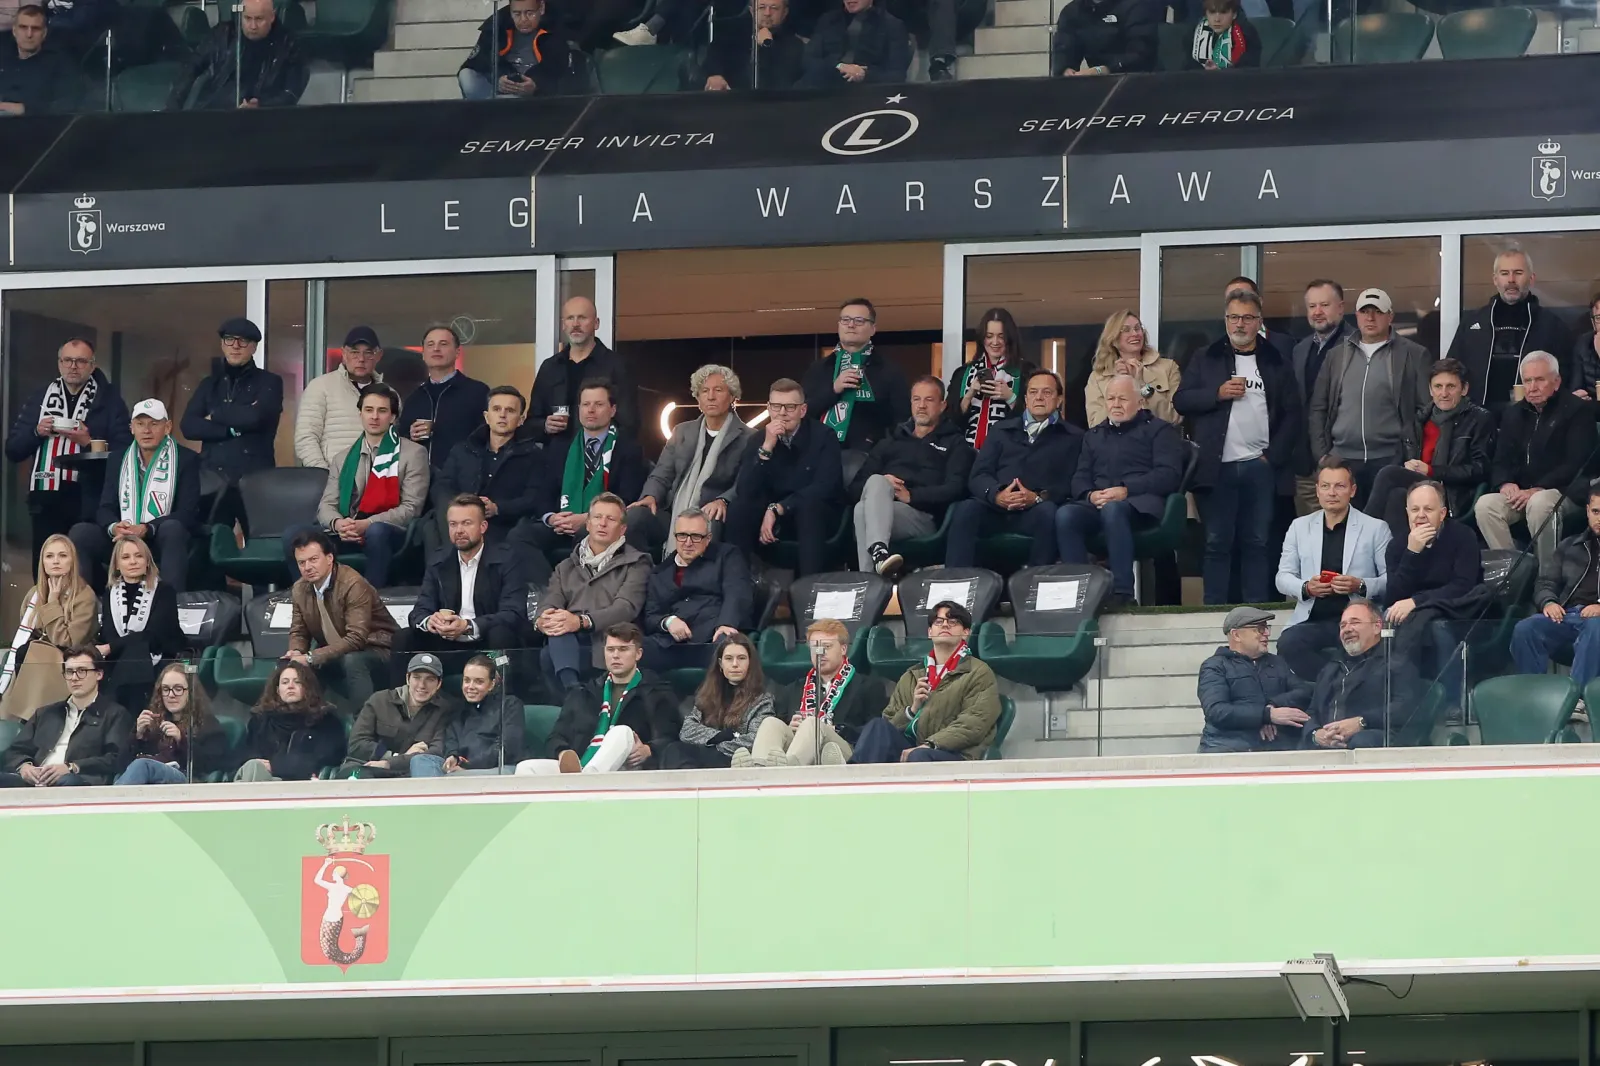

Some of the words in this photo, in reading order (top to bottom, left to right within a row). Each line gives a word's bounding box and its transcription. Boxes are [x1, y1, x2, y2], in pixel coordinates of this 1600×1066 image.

[1019, 114, 1146, 133] SEMPER
[1158, 107, 1294, 126] HEROICA
[460, 137, 585, 154] SEMPER
[596, 132, 715, 149] INVICTA
[1570, 169, 1600, 180] Wars
[380, 192, 653, 233] LEGIA
[756, 169, 1279, 218] WARSZAWA
[105, 222, 166, 234] Warszawa
